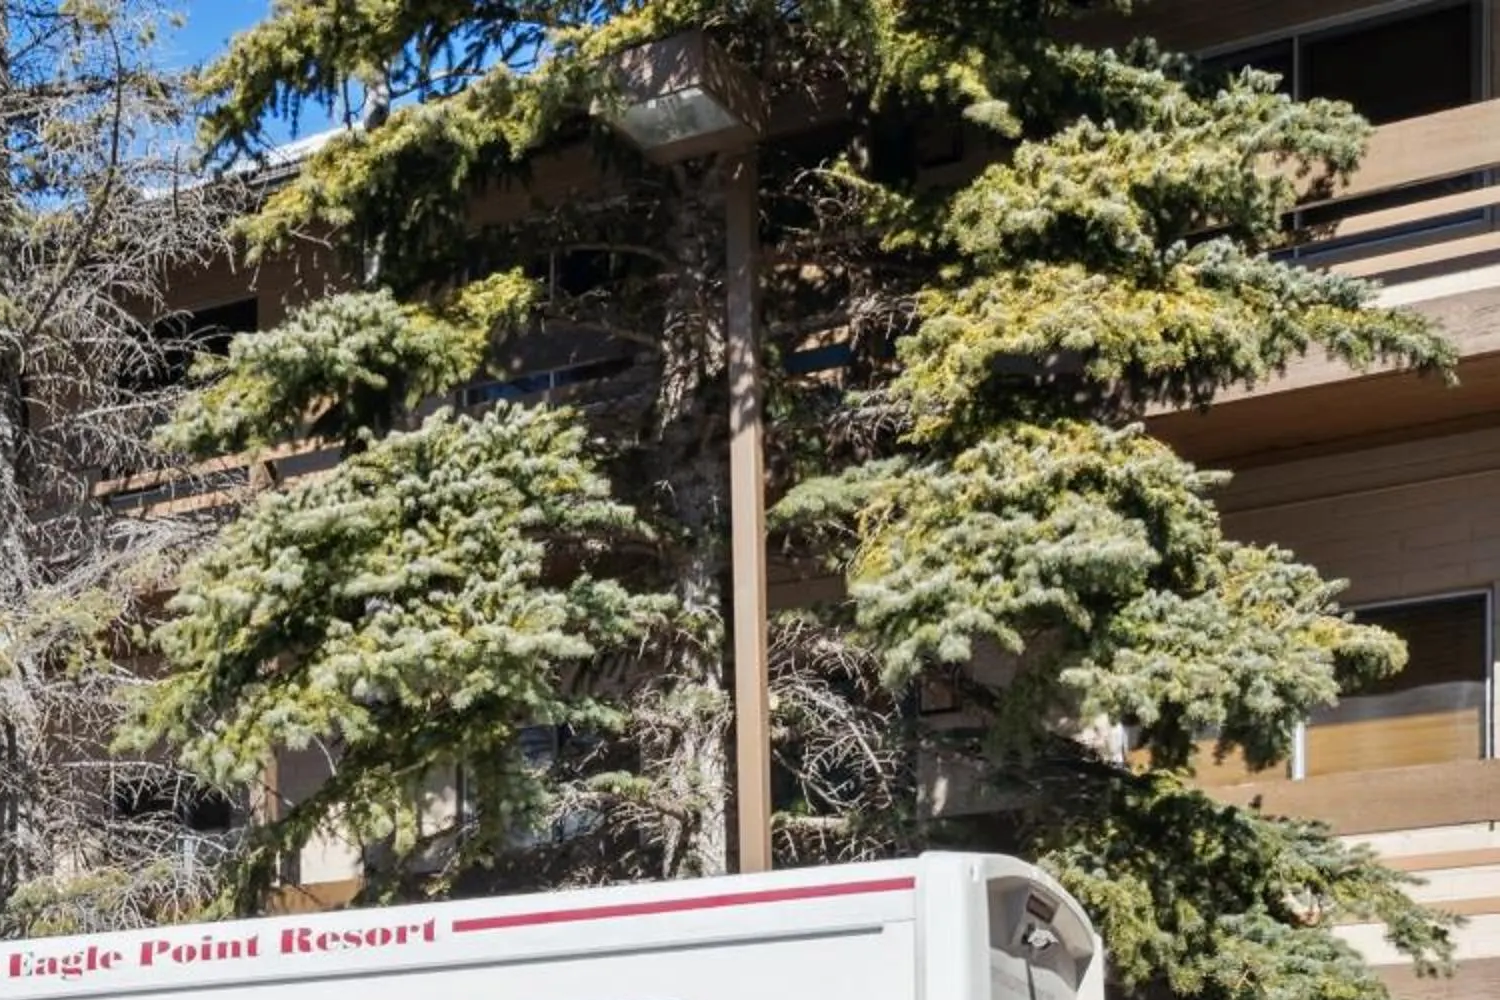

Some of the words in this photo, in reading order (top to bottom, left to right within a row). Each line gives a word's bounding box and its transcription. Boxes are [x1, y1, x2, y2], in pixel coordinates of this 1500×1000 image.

[8, 945, 123, 980] Eagle
[139, 934, 261, 967] Point
[280, 917, 436, 955] Resort
